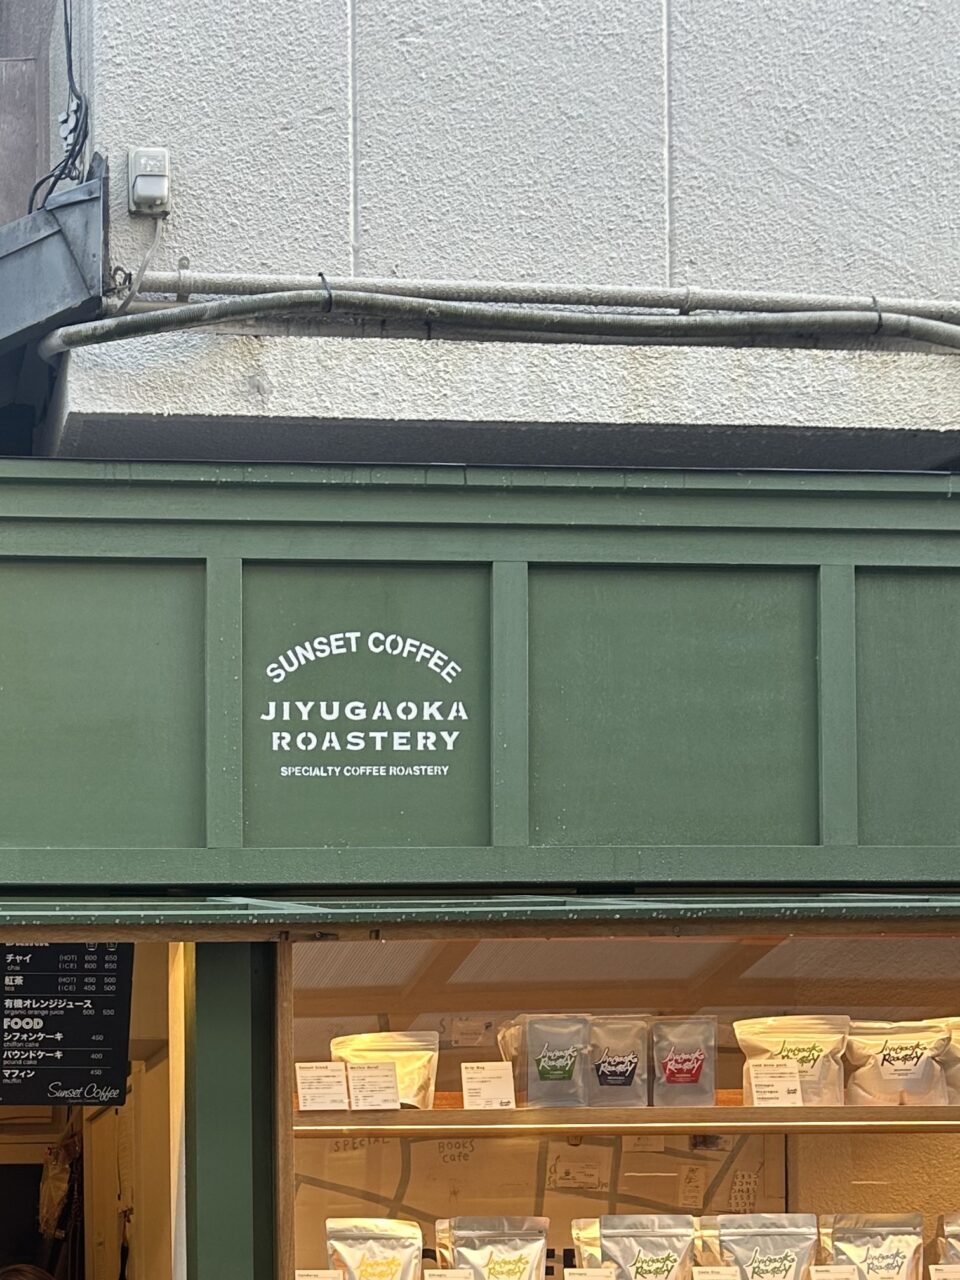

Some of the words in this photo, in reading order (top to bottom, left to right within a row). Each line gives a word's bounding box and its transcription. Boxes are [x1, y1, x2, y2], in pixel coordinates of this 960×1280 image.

[267, 632, 360, 682] SUNSET
[368, 632, 461, 683] COFFEE
[261, 702, 468, 720] JIYUGAOKA
[273, 732, 459, 750] ROASTERY
[281, 767, 341, 776] SPECIALTY
[344, 766, 386, 776] COFFEE
[389, 766, 448, 775] ROASTERY
[6, 954, 31, 963] チャイ
[5, 976, 23, 985] 紅茶
[4, 999, 92, 1008] 有機オレンジジュース
[4, 1018, 43, 1029] FOOD
[4, 1032, 63, 1040] シフォンケーキ
[48, 1082, 82, 1099] Sunset
[84, 1083, 119, 1099] Coffee
[438, 1139, 475, 1151] BOOKS
[442, 1151, 470, 1163] cafe
